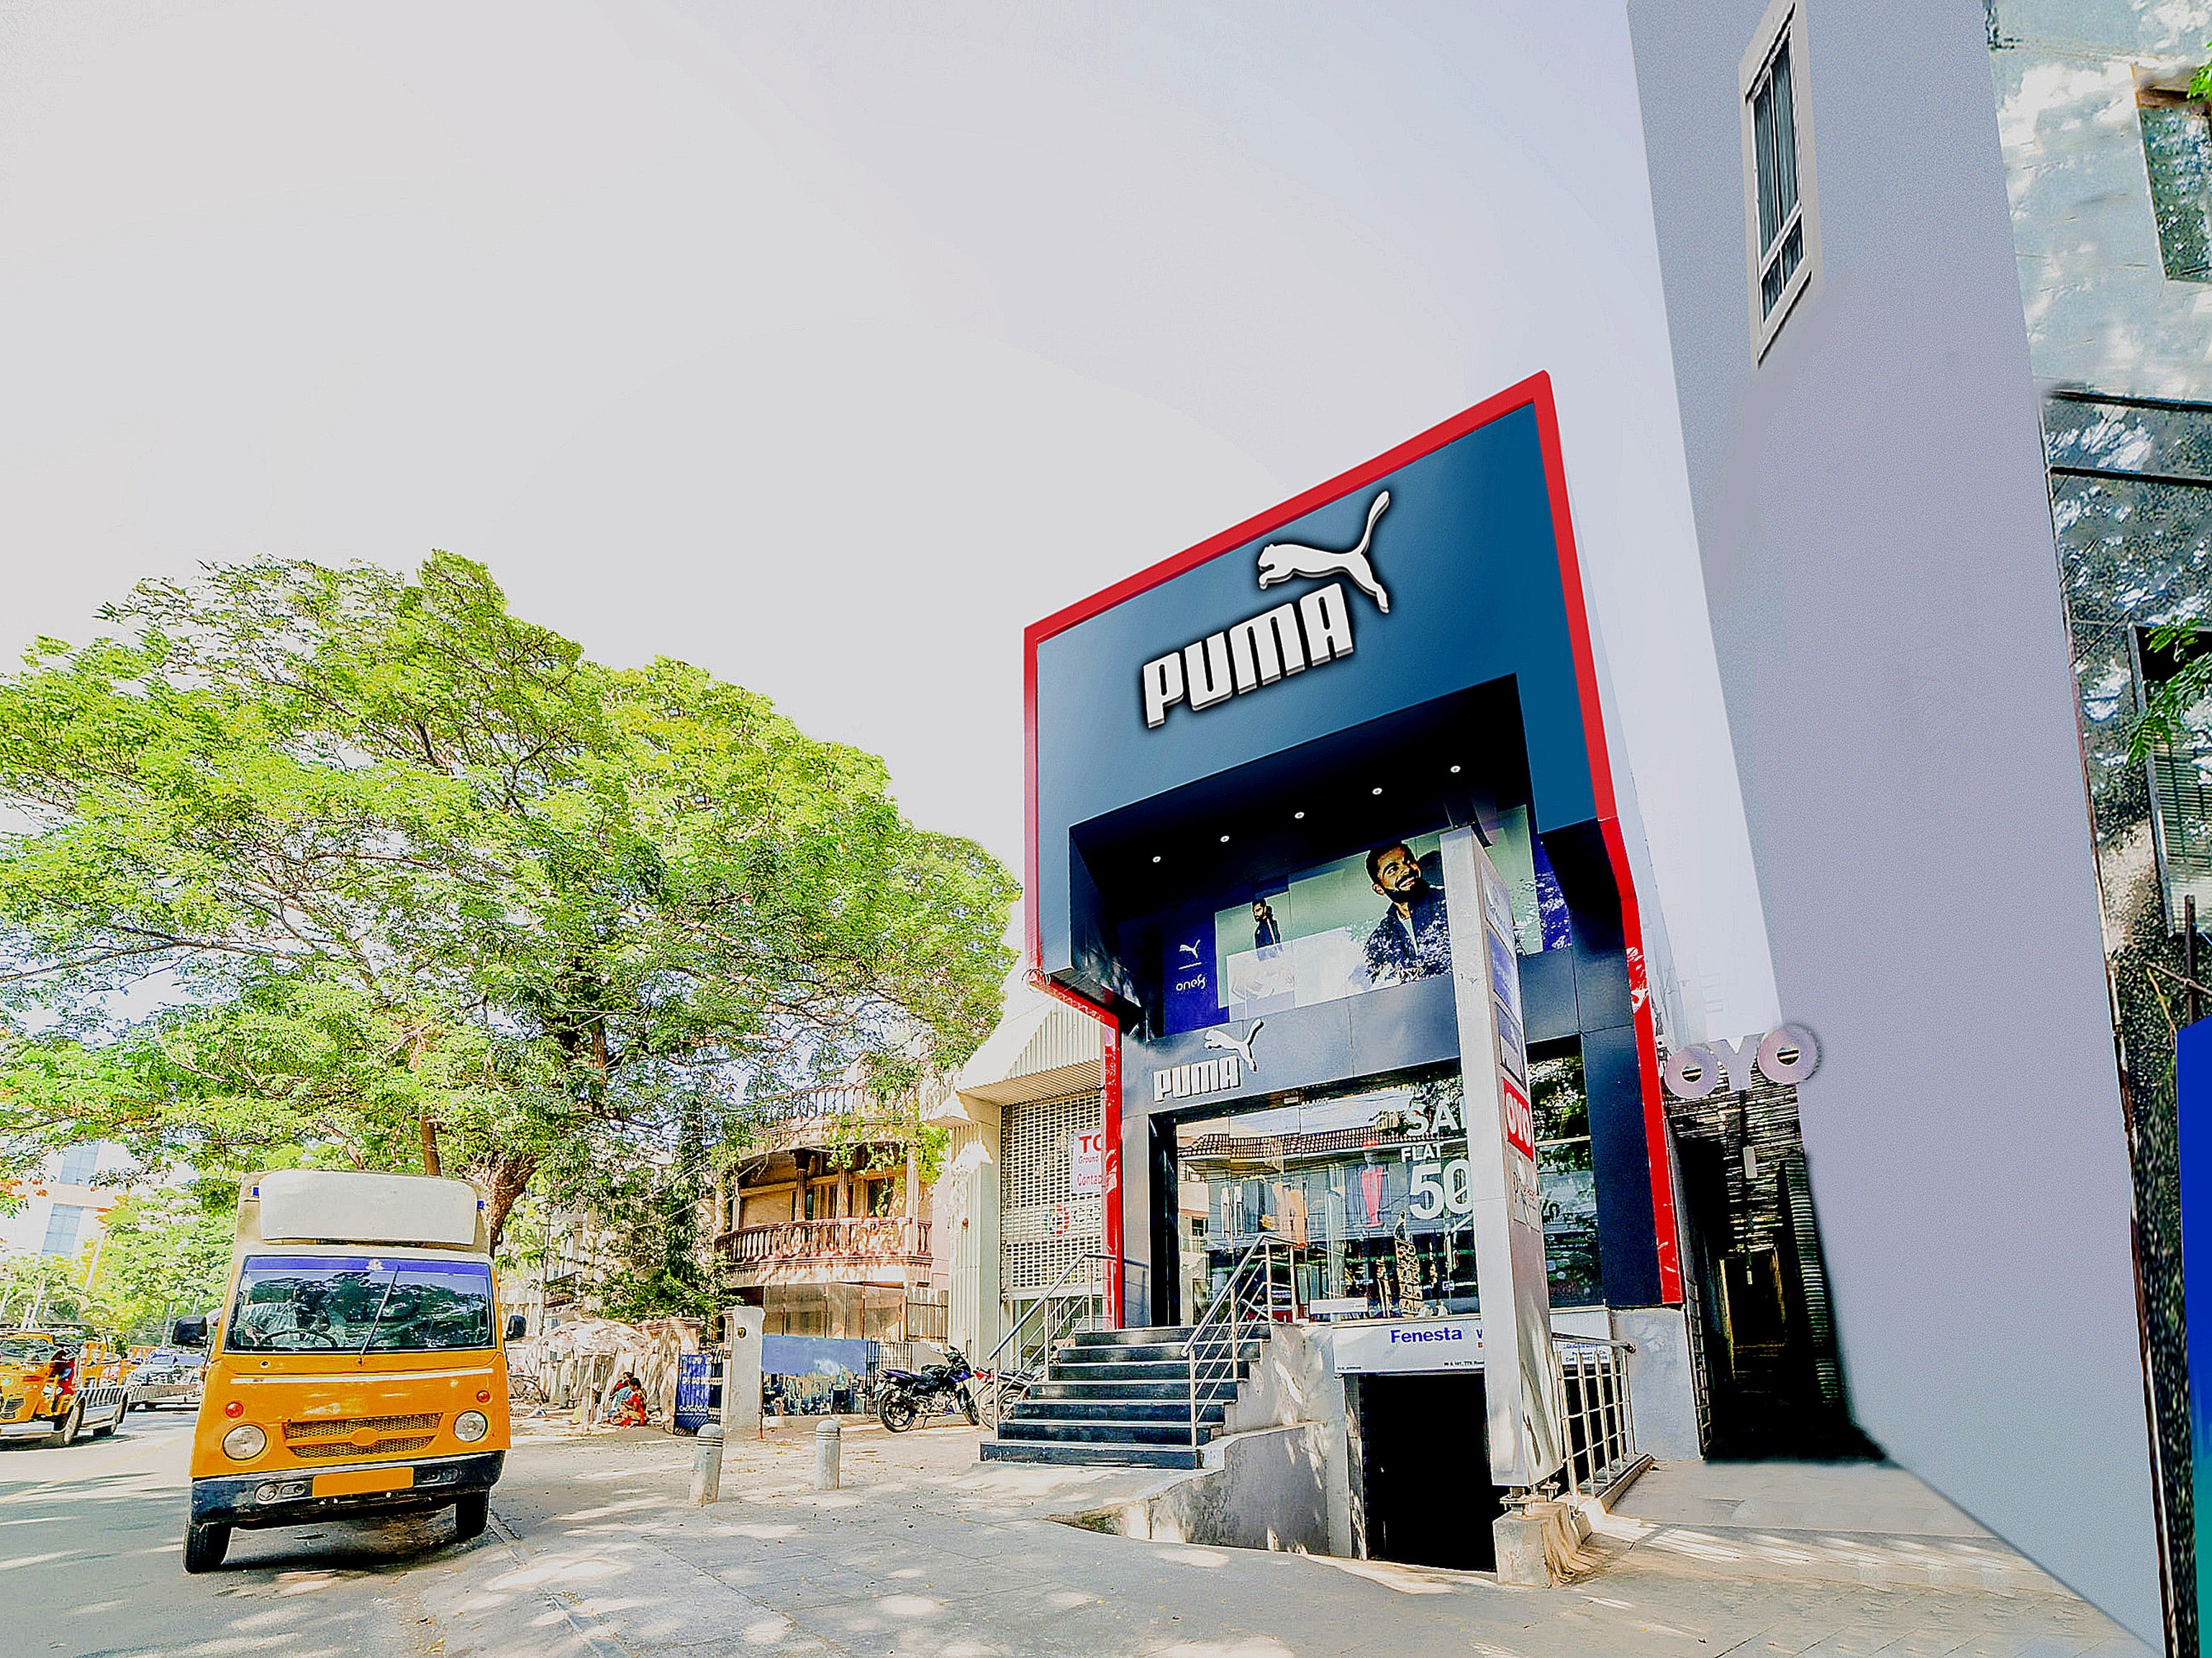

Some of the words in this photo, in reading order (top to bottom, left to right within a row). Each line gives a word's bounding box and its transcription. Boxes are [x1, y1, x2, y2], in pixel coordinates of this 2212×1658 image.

[1143, 582, 1354, 728] PUMA
[1153, 1055, 1241, 1102] PUMA
[1664, 1026, 1821, 1100] OYO
[1401, 1143, 1444, 1163] FLAT
[1409, 1159, 1474, 1220] 50
[1390, 1327, 1463, 1343] Fenesta
